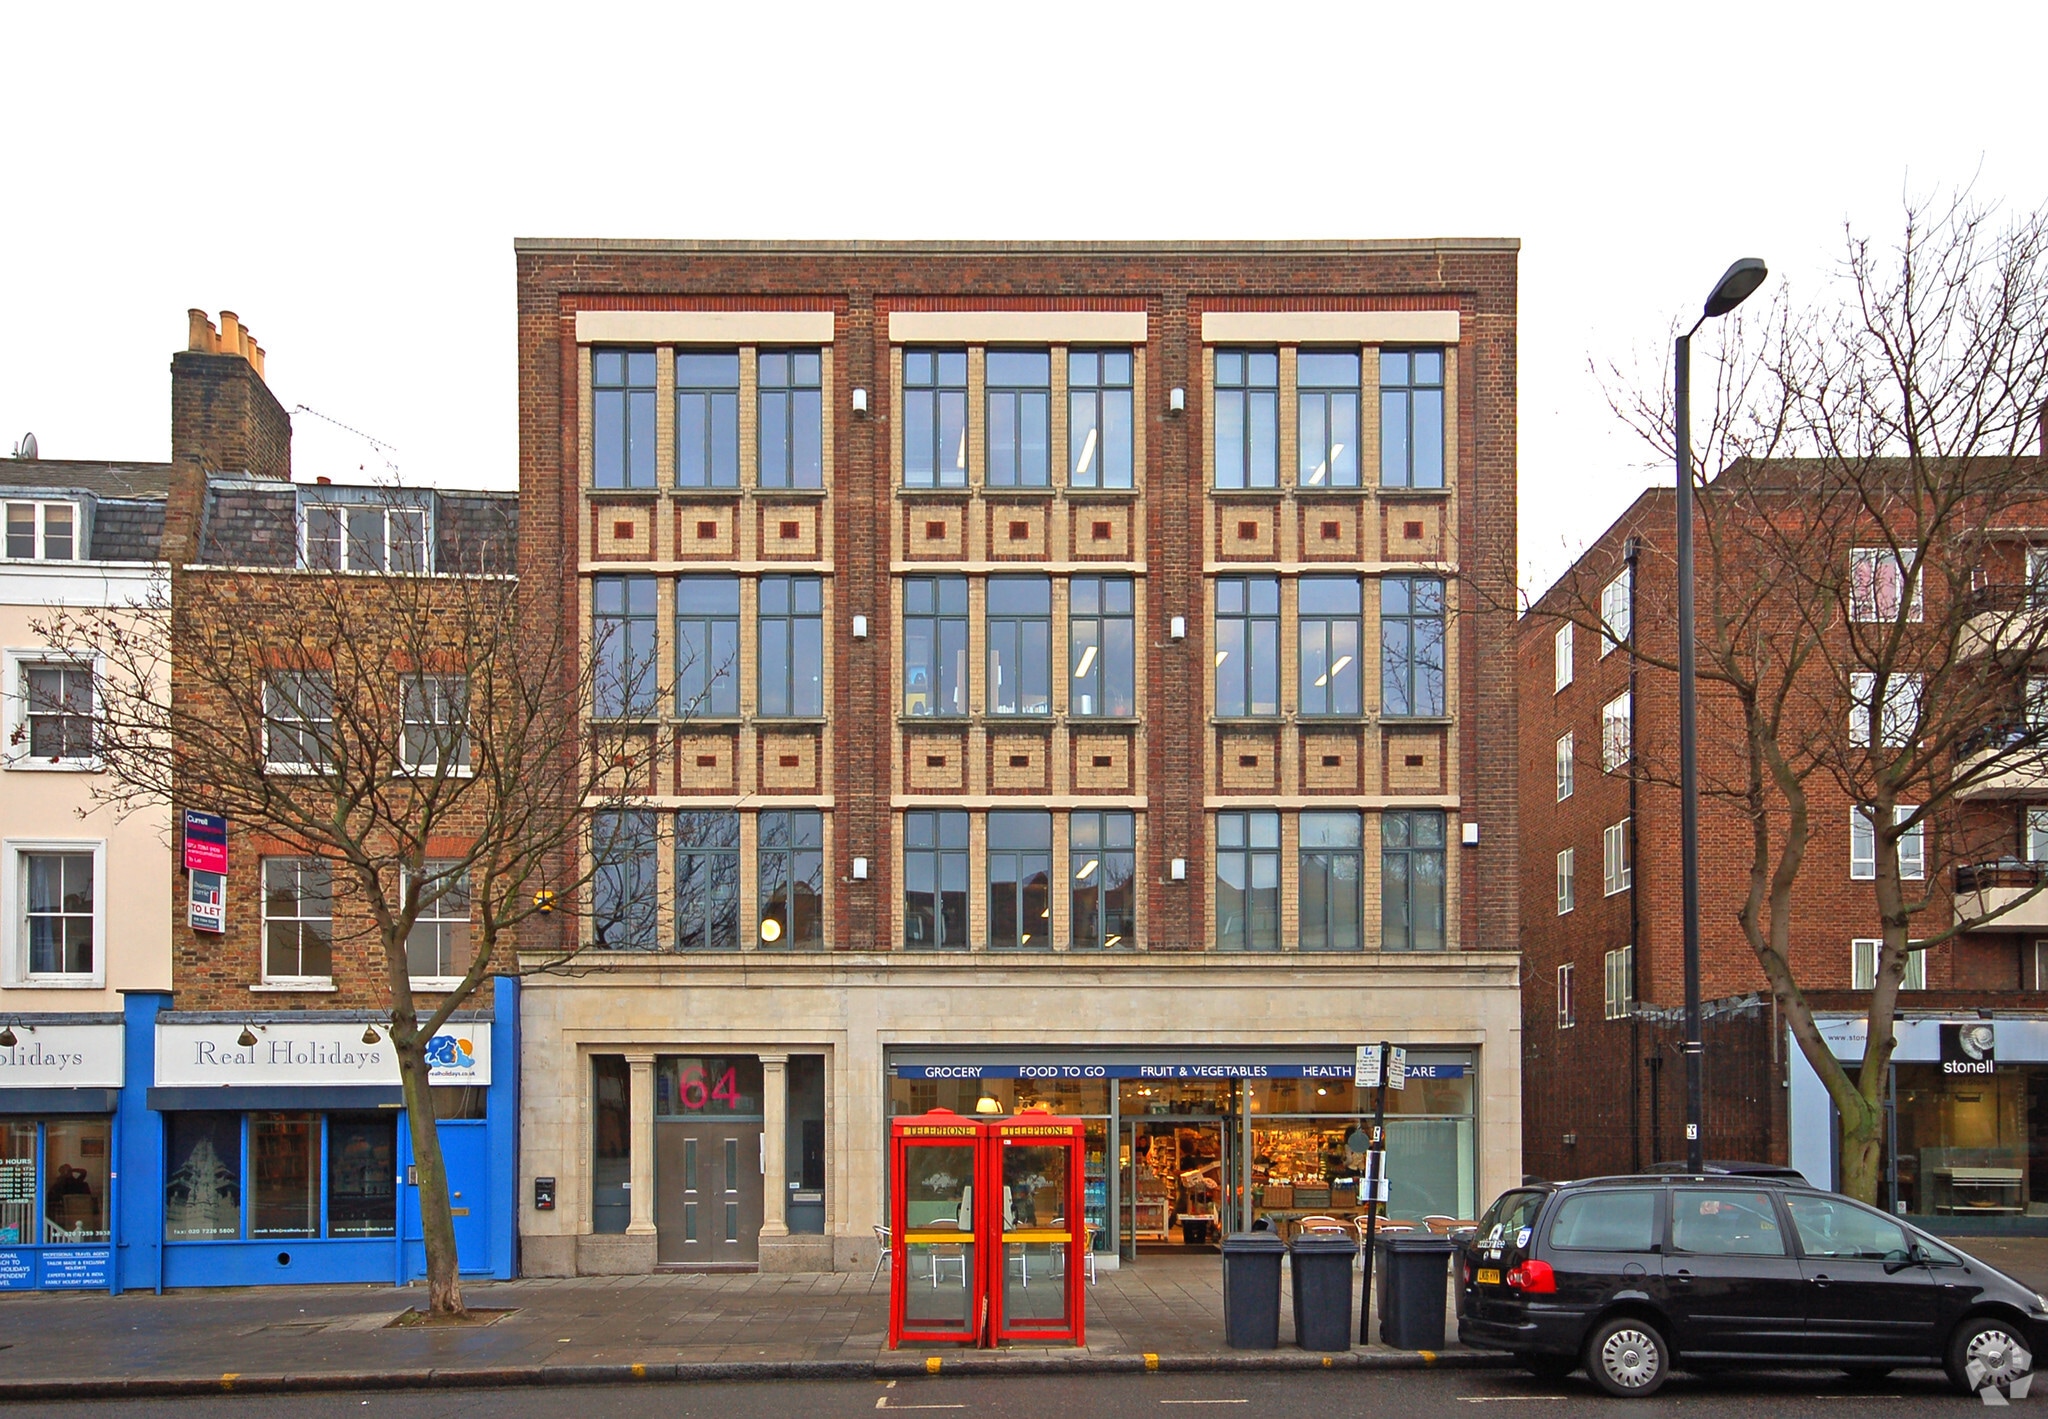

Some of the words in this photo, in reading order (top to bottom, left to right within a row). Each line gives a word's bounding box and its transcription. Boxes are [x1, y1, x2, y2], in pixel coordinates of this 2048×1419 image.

[191, 903, 203, 913] TO
[204, 905, 222, 917] LET
[194, 1041, 256, 1065] Real
[267, 1041, 381, 1069] Holidays
[925, 1066, 983, 1078] GROCERY
[1019, 1066, 1058, 1077] FOOD
[1062, 1066, 1081, 1077] TO
[1084, 1066, 1106, 1077] GO
[1140, 1066, 1175, 1077] FRUIT
[1179, 1066, 1188, 1077] &
[1192, 1065, 1267, 1077] VEGETABLES
[1302, 1066, 1352, 1077] HEALTH
[1943, 1060, 1994, 1073] stonell
[680, 1065, 742, 1110] 64
[909, 1126, 971, 1136] TELEPHONE
[1006, 1126, 1069, 1136] TELEPHONE
